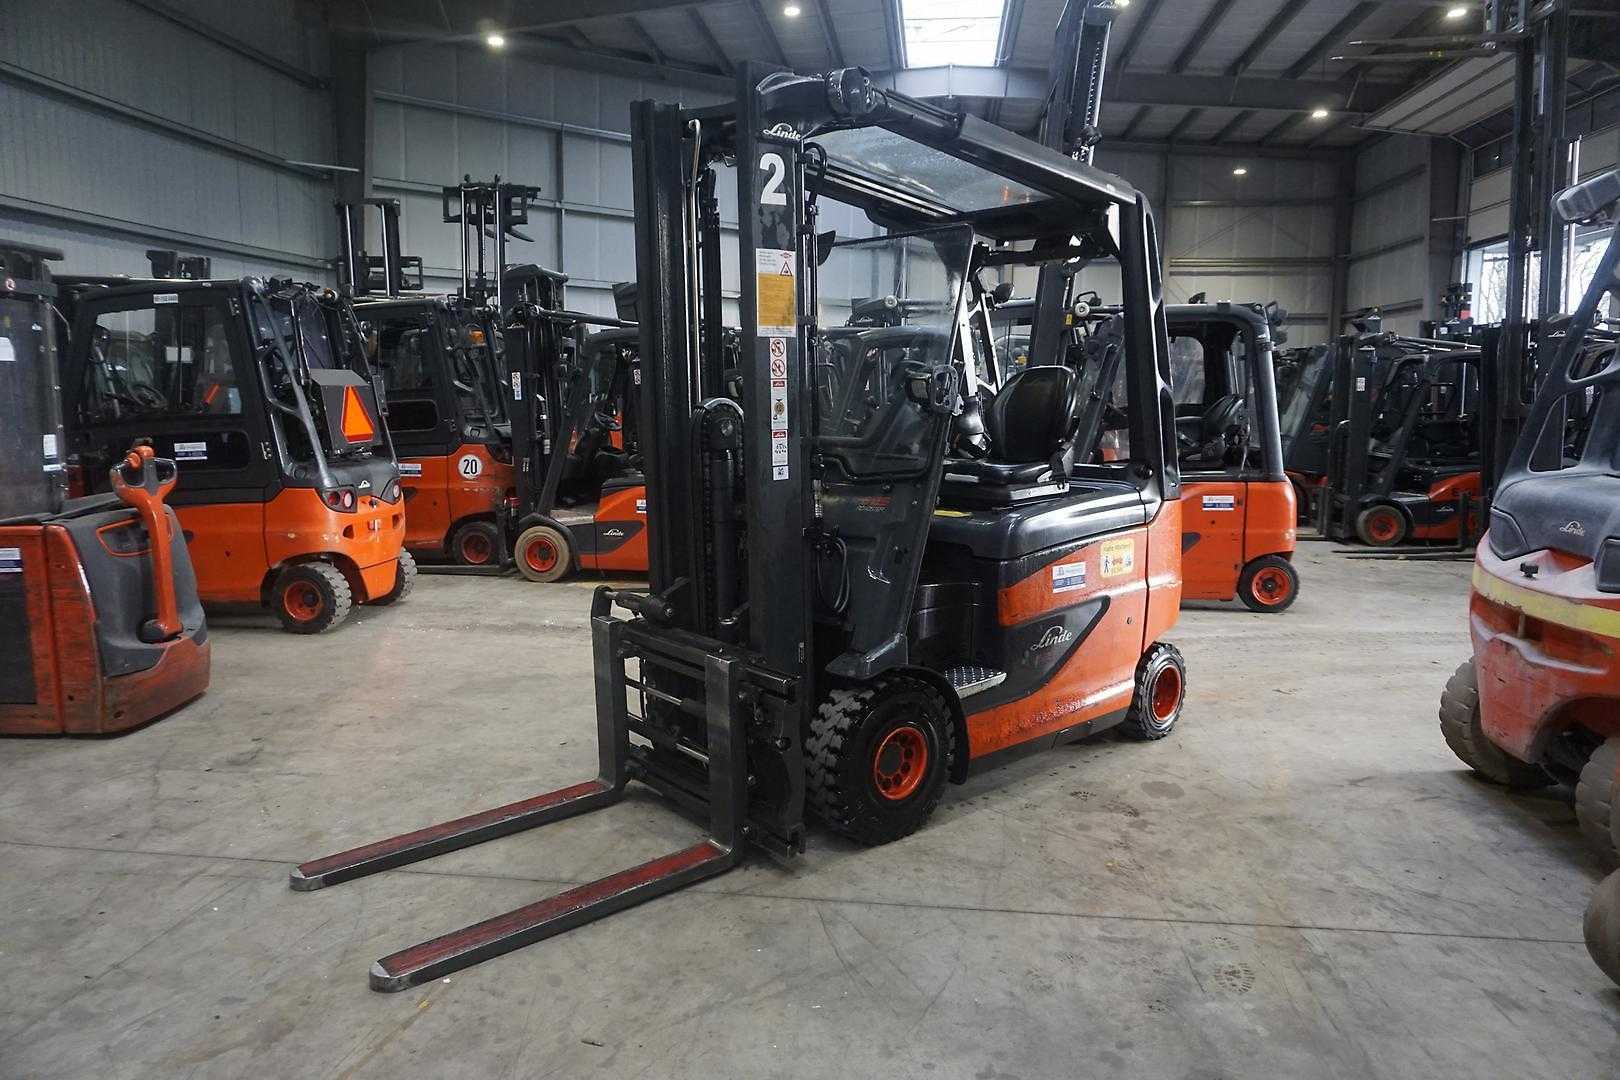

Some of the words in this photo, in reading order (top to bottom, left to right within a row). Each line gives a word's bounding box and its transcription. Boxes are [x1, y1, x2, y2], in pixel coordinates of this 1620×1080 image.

[762, 122, 801, 141] Linde
[759, 152, 787, 206] 2
[463, 459, 478, 475] 20
[1029, 625, 1072, 651] Linde
